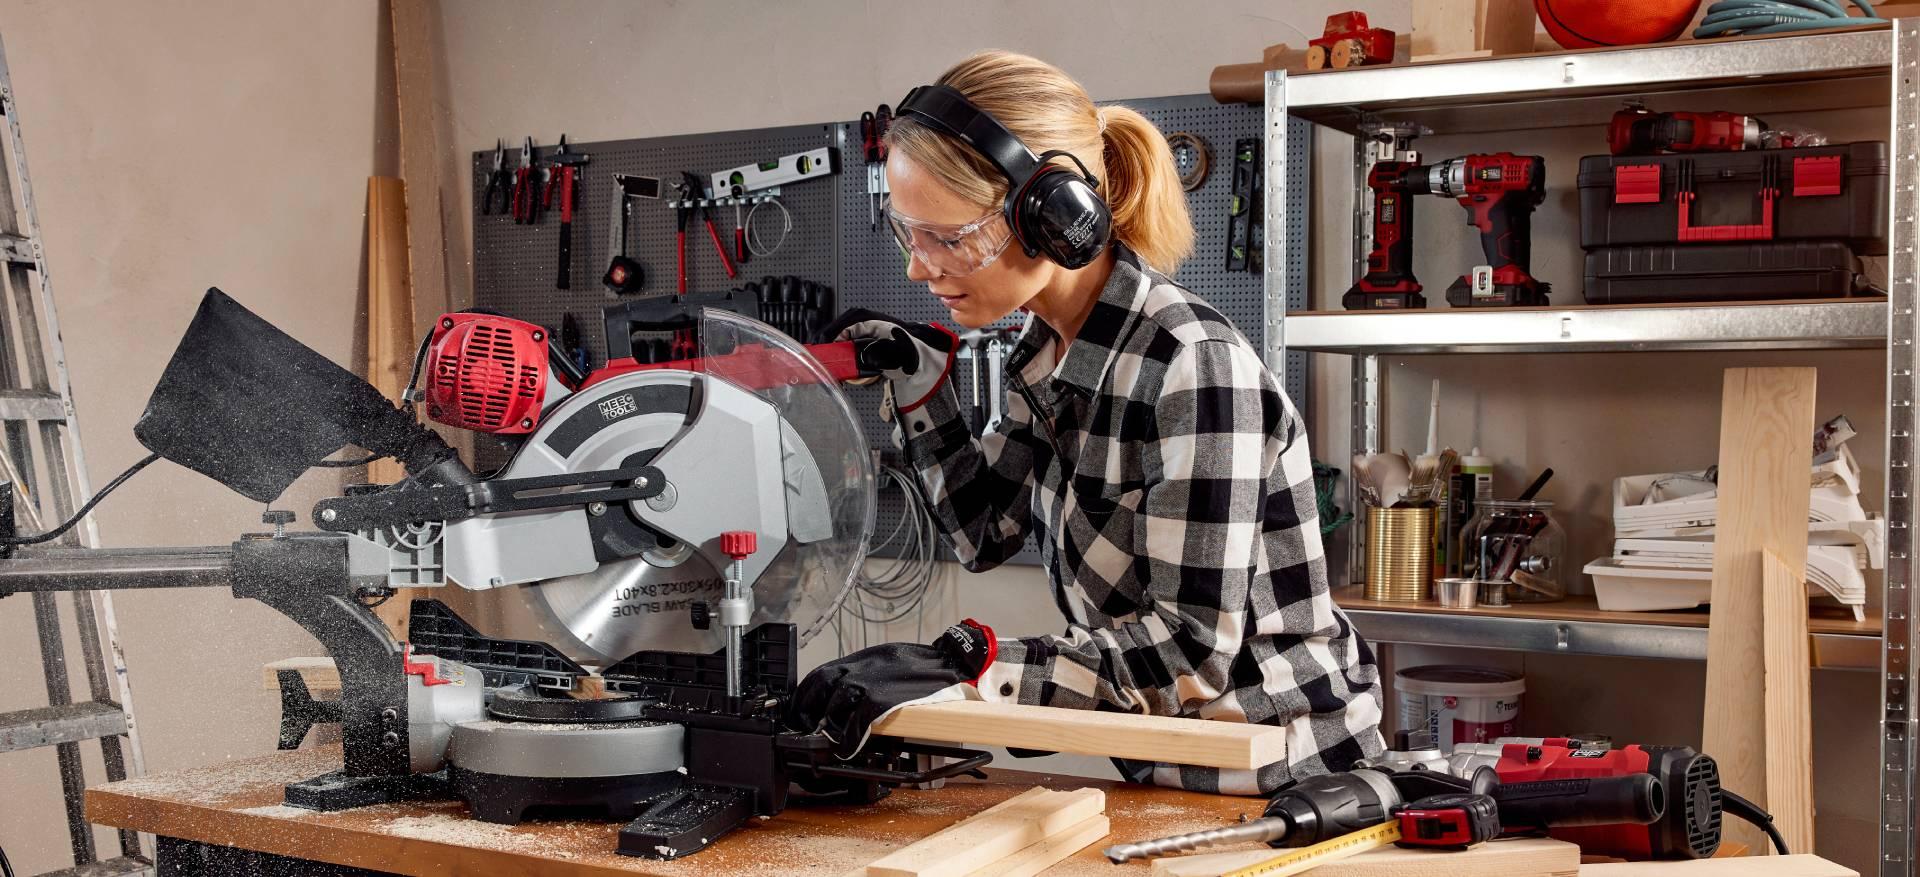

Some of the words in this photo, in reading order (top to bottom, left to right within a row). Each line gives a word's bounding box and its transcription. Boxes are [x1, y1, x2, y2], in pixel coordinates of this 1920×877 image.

[598, 393, 635, 413] MEEC
[602, 403, 638, 421] TOOLS
[614, 577, 723, 601] 05x30x2.8x40T
[612, 601, 660, 617] BLADE
